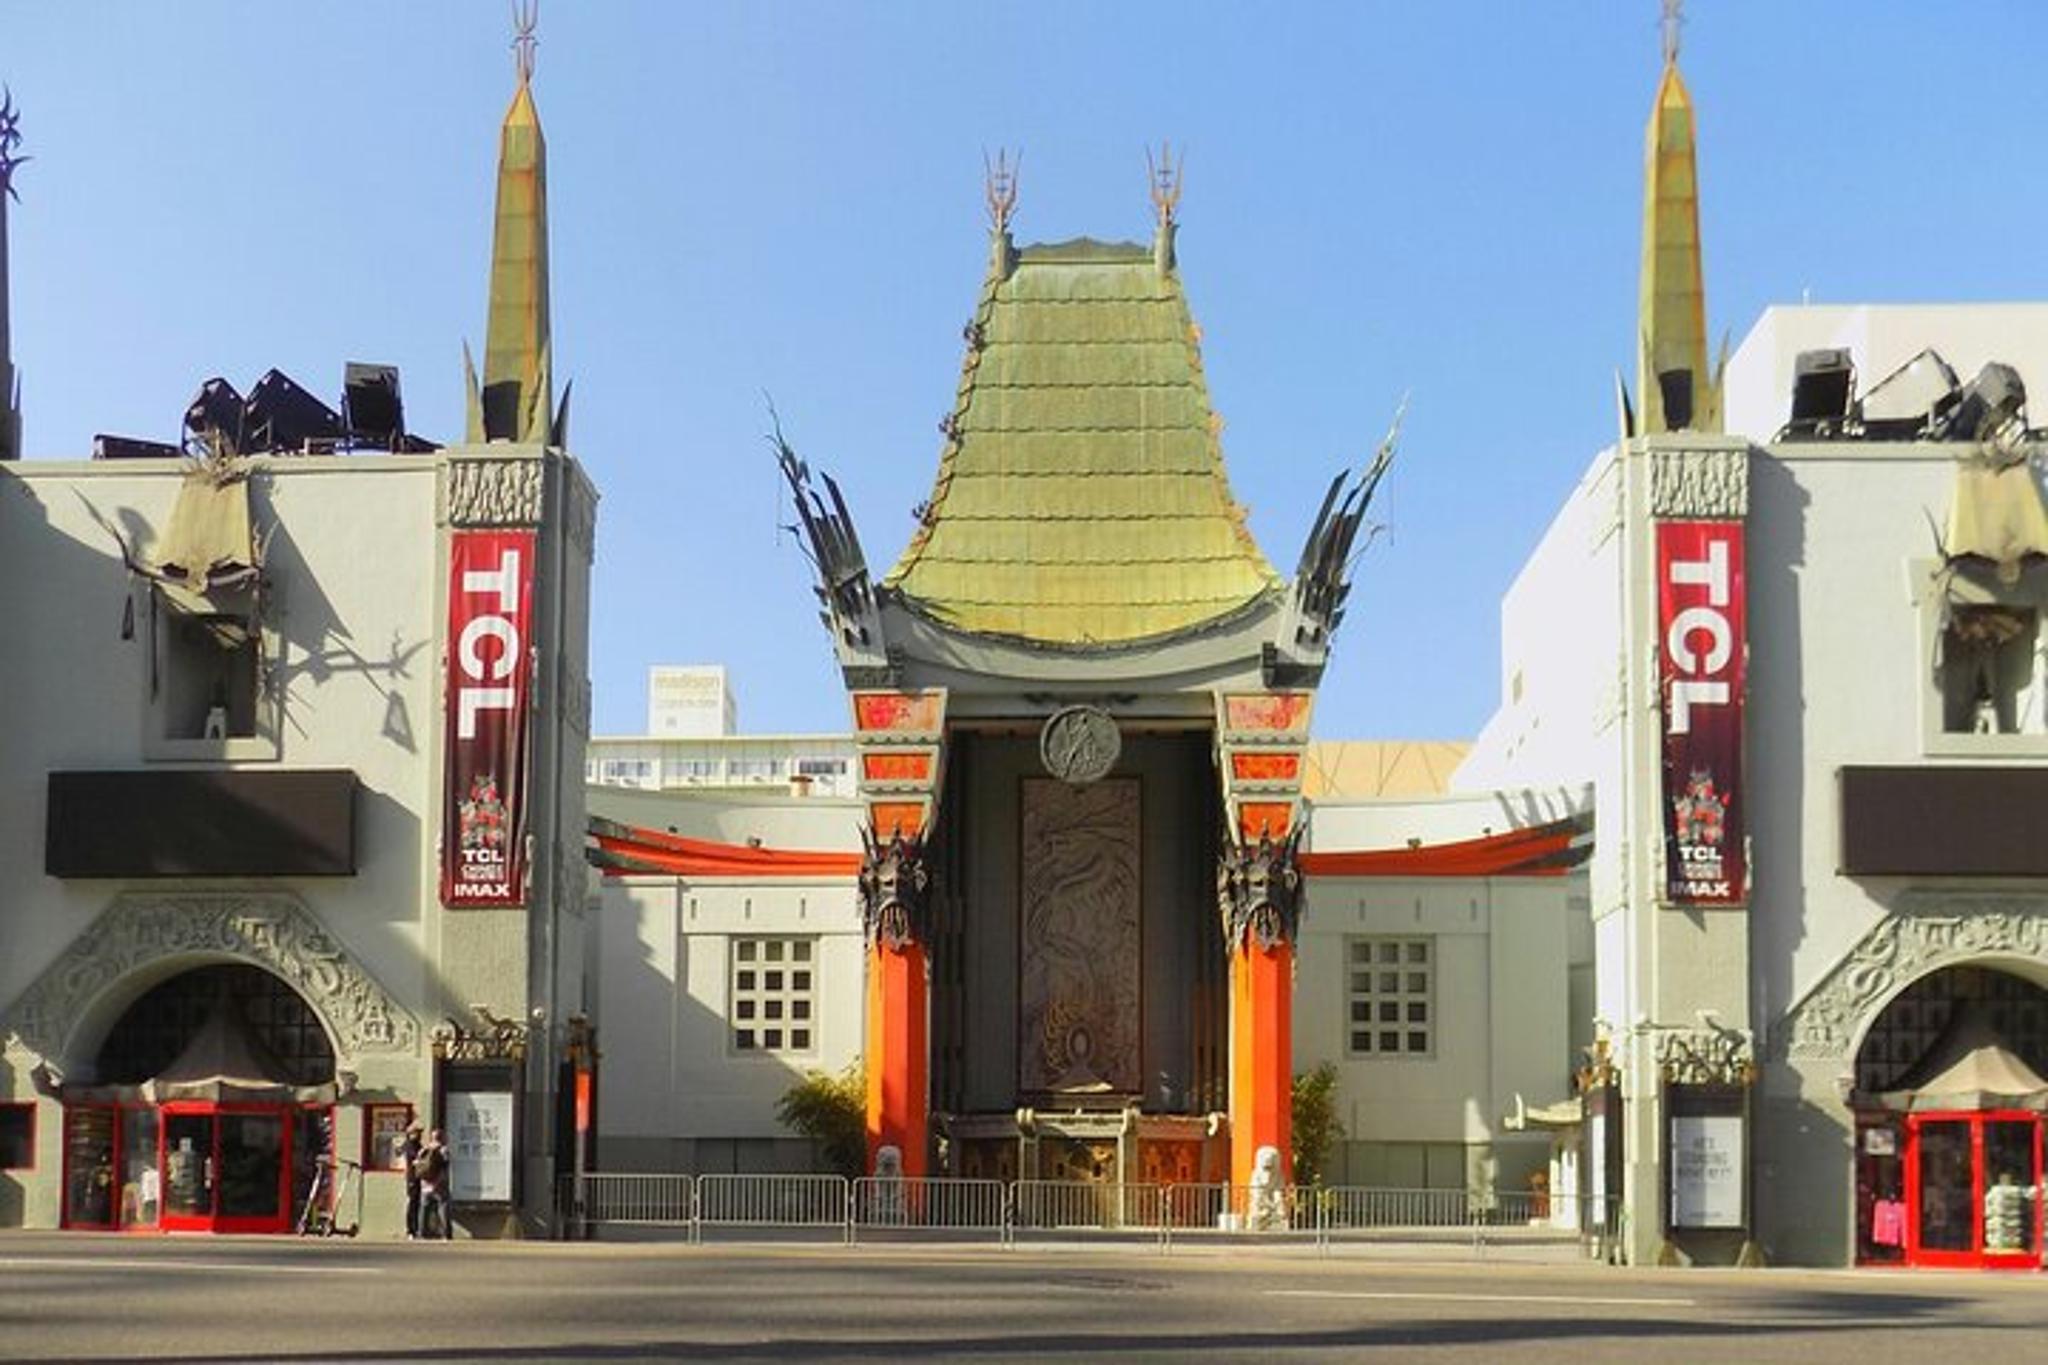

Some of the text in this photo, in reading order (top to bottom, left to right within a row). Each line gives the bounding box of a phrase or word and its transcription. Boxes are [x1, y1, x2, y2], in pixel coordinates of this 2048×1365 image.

[457, 549, 519, 740] TCL
[1668, 540, 1732, 734] TCL
[461, 849, 504, 863] TCL
[1679, 846, 1723, 861] TCL
[454, 883, 510, 898] IMAX
[1670, 881, 1730, 897] IMAX
